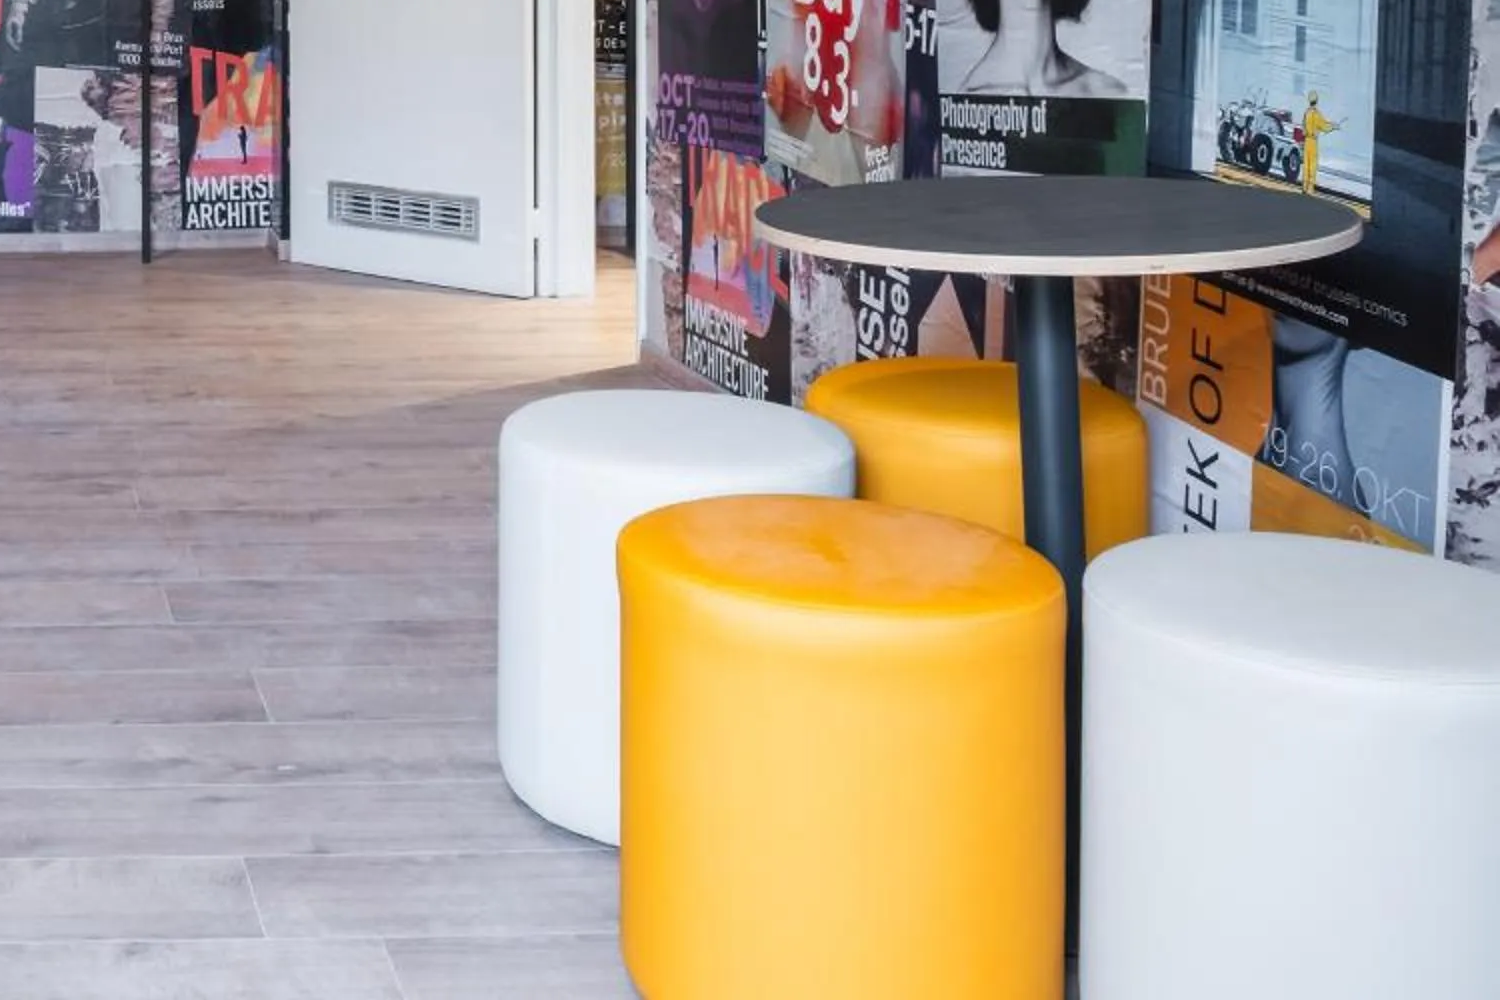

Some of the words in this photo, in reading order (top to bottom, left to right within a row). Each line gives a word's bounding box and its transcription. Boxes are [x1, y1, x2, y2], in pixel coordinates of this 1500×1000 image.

[804, 12, 859, 125] 8.3.
[660, 72, 696, 108] OCT
[940, 96, 1029, 138] Photography
[1032, 100, 1048, 133] of
[941, 133, 1008, 169] Presence
[185, 174, 275, 202] IMMERSI
[186, 201, 272, 229] ARCHITE
[685, 293, 749, 357] IMMERSIVE
[1362, 299, 1409, 328] comics
[1189, 327, 1225, 425] OF
[1352, 465, 1430, 542] OKT
